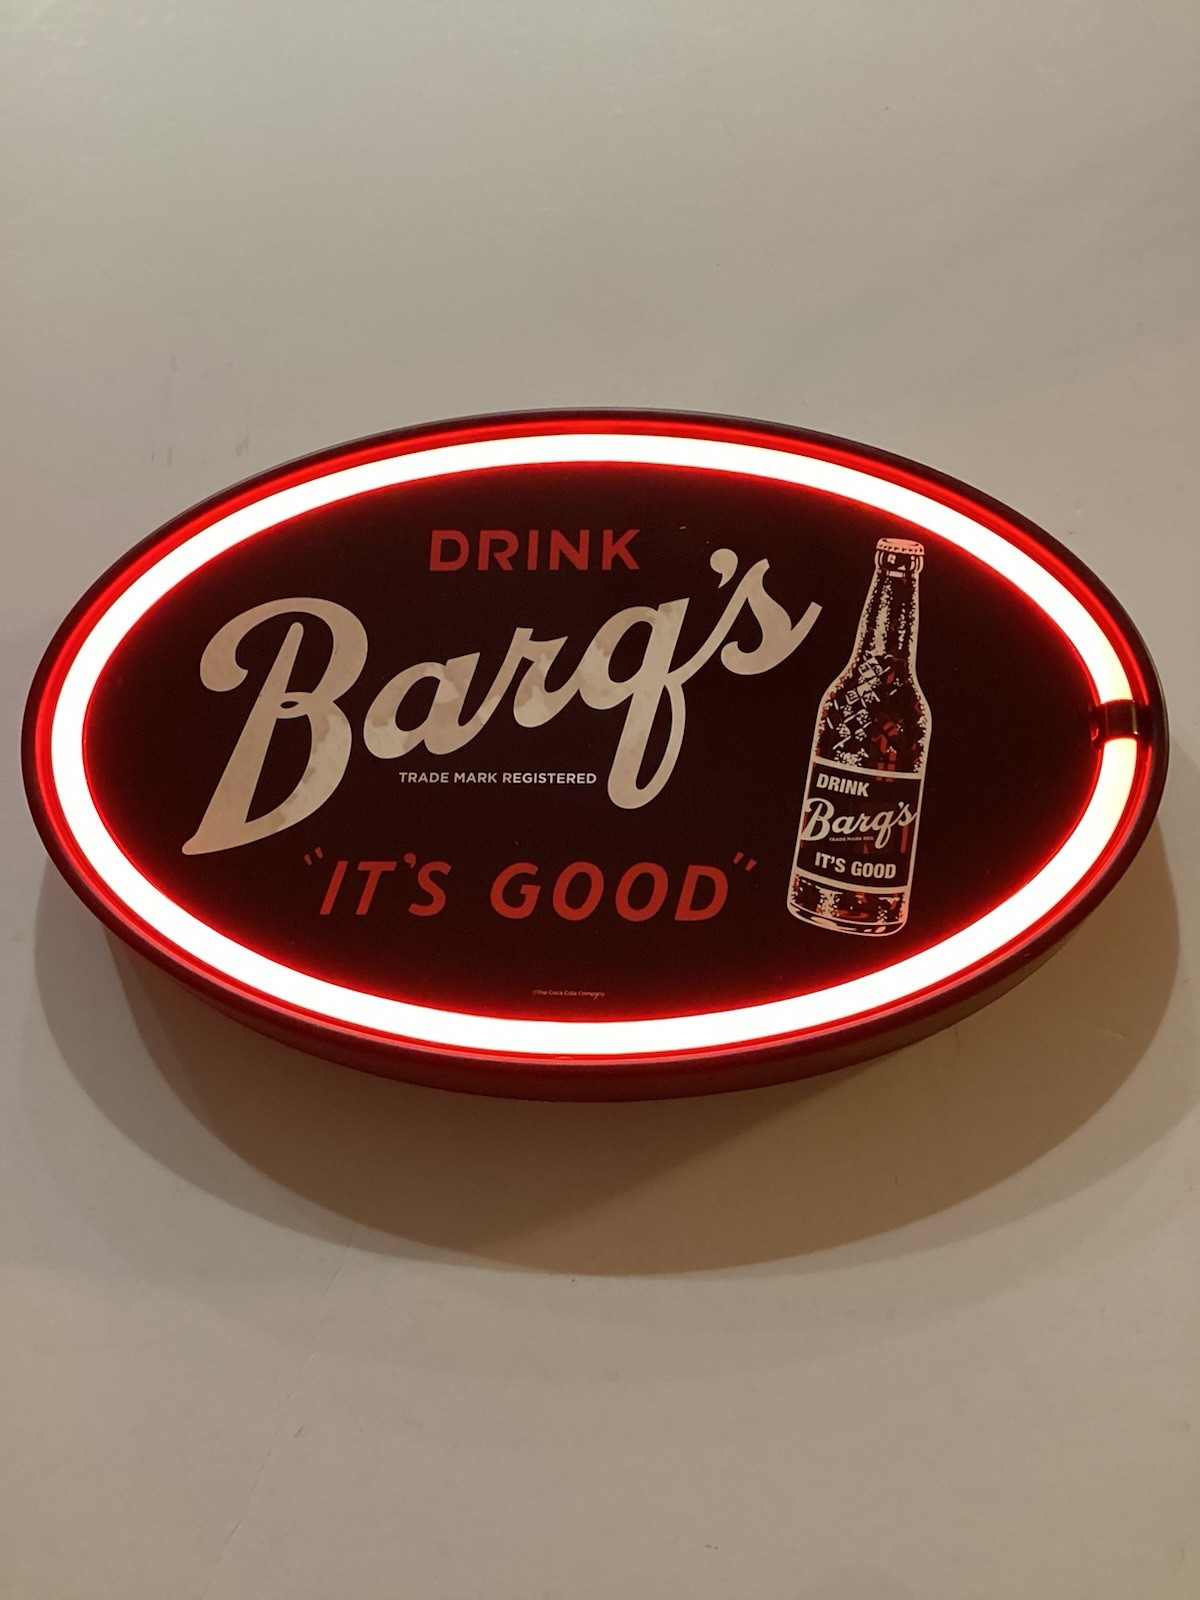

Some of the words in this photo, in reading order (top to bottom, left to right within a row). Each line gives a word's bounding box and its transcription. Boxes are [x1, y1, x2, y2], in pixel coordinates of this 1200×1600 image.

[429, 529, 641, 571] DRINK
[181, 548, 823, 856] Barq's
[398, 771, 449, 784] TRADE
[453, 772, 498, 784] MARK
[502, 772, 597, 785] REGISTERED
[816, 773, 870, 797] DRINK
[800, 797, 918, 849] Barq's
[815, 851, 846, 873] IT'S
[851, 861, 896, 879] GOOD
